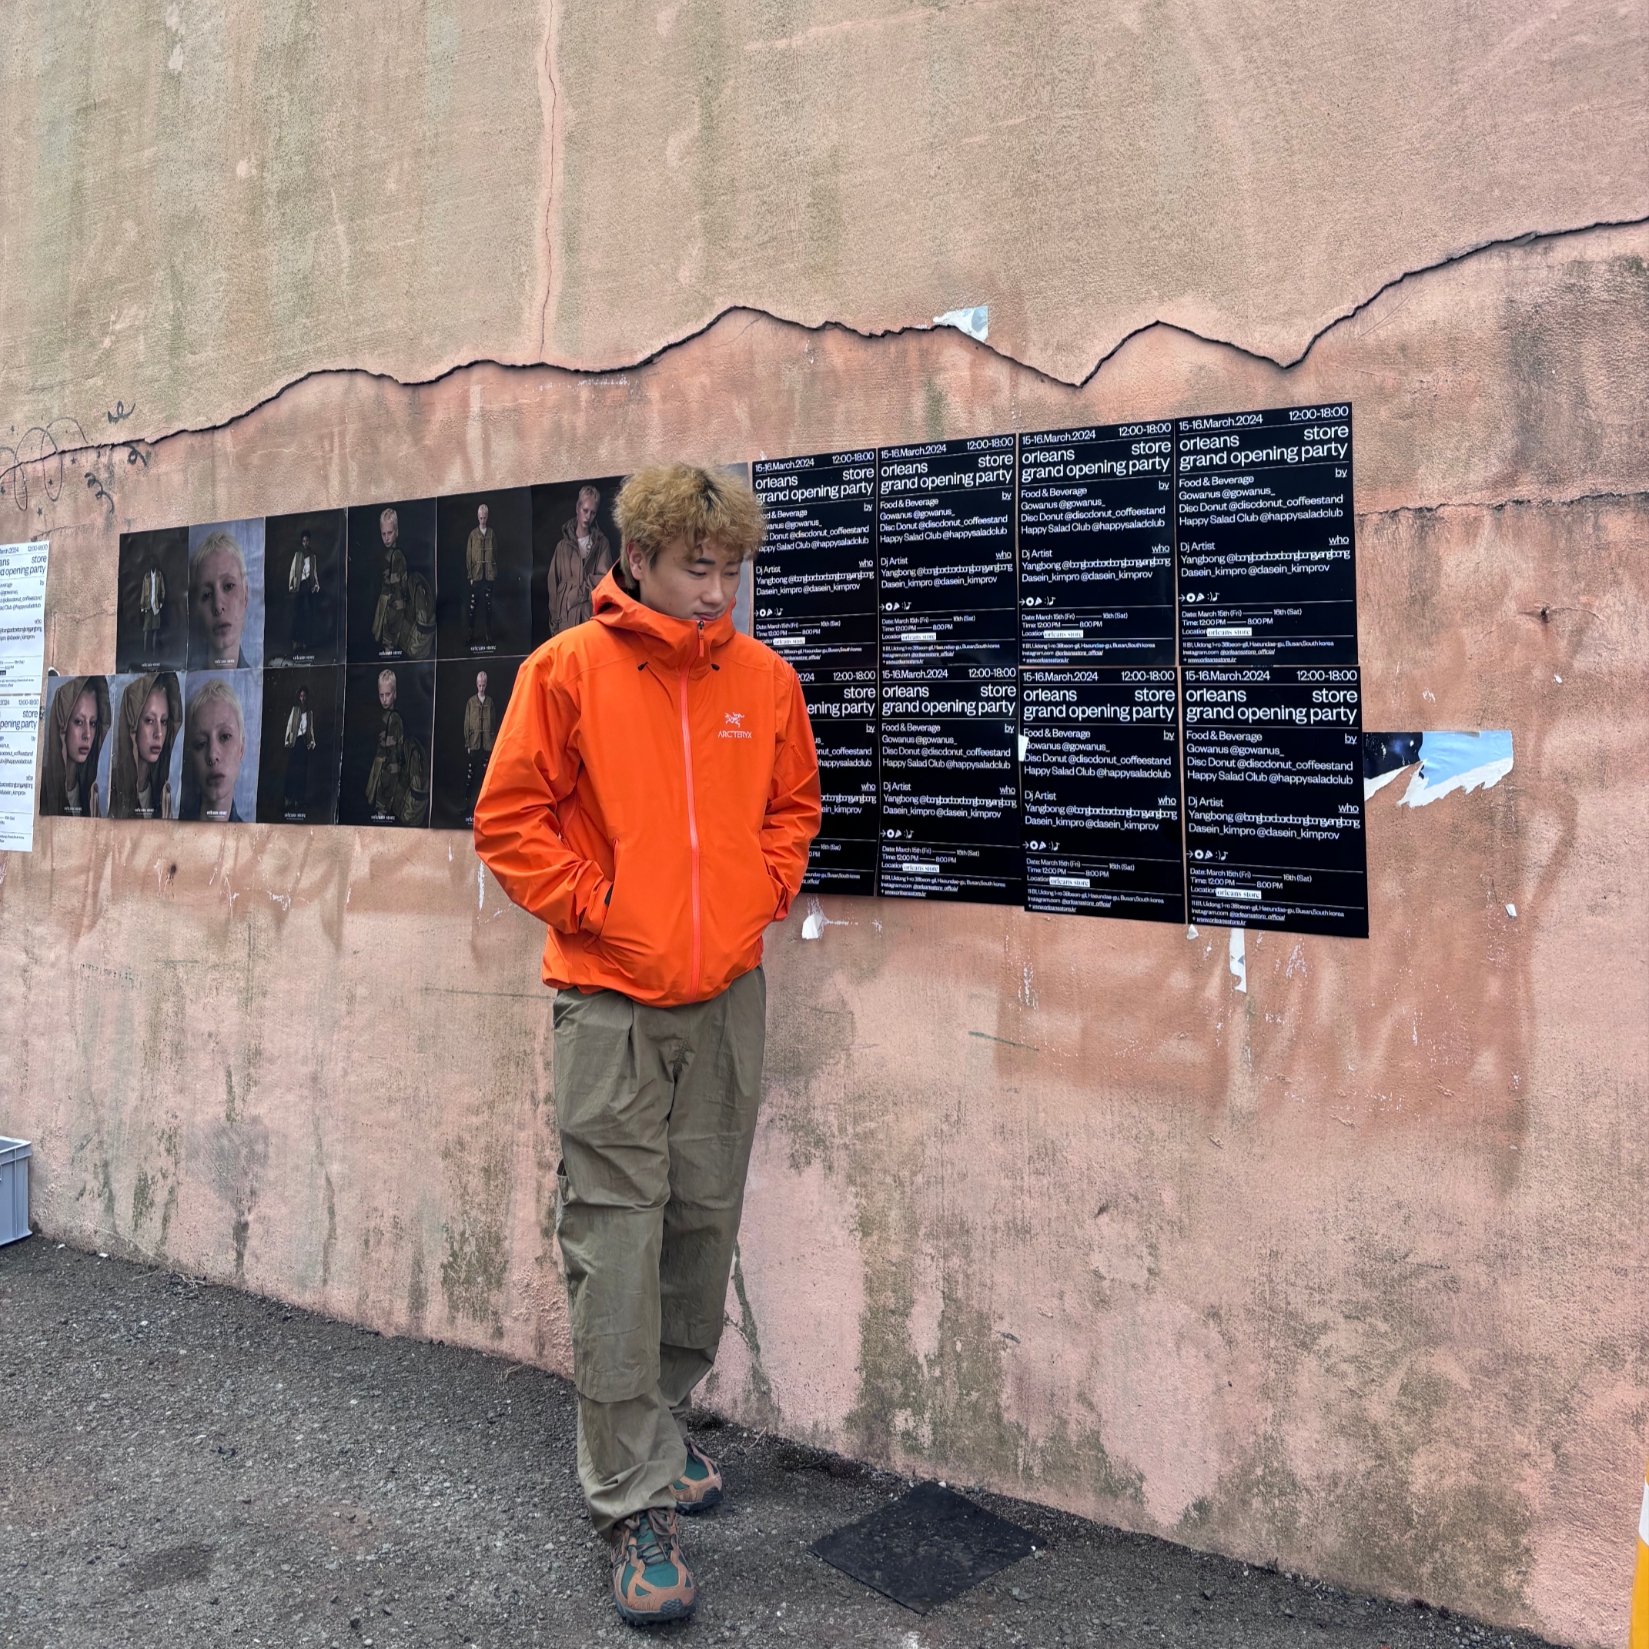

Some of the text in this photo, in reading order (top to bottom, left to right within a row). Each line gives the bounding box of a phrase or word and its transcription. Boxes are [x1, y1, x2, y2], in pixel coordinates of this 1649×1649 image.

[1289, 406, 1349, 421] 12:00-18:00
[1119, 423, 1171, 436] 12:00-18:00
[967, 437, 1013, 450] 12:00-18:00
[1180, 426, 1349, 451] orleans store
[1022, 441, 1171, 464] orleans store
[1179, 441, 1348, 471] grand opening party
[881, 454, 1013, 477] orleans store
[1021, 456, 1170, 483] grand opening party
[755, 468, 874, 489] orleans store
[1335, 468, 1347, 478] by
[880, 468, 1012, 494] grand opening party
[1159, 480, 1169, 490] by
[1179, 476, 1254, 487] Food & Beverage
[791, 485, 839, 502] opening
[841, 481, 873, 498] party
[1021, 488, 1087, 498] Food & Beverage
[1179, 488, 1275, 500] Gowanus @gowanus_
[1021, 499, 1105, 510] Gowanus @gowanus_
[1179, 494, 1343, 513] Disc Donut @discdonut_coffeestand
[1179, 508, 1343, 527] Happy Salad Club @happysaladclub
[1021, 518, 1165, 535] Happy Salad Club @happysaladclub
[1329, 535, 1349, 545] who
[1152, 543, 1170, 553] who
[1180, 541, 1215, 553] Dj Artist
[31, 554, 47, 564] store
[1022, 549, 1052, 560] Dj Artist
[1181, 554, 1225, 565] Yangbong
[6, 565, 46, 577] opening party
[1022, 561, 1061, 571] Yangbong
[968, 667, 1016, 678] 12:00-18:00
[1121, 670, 1175, 681] 12:00-18:00
[1297, 670, 1357, 681] 12:00-18:00
[844, 686, 876, 698] store
[882, 684, 1016, 698] orleans store
[1023, 687, 1175, 701] orleans store
[1186, 688, 1358, 703] orleans store
[882, 699, 1015, 716] grand opening party
[1023, 703, 1174, 722] grand opening party
[22, 710, 38, 718] store
[1186, 705, 1357, 725] grand opening party
[21, 720, 38, 730] party
[1023, 728, 1091, 739] Food & Beverage
[1163, 730, 1174, 741] by
[1186, 730, 1262, 742] Food & Beverage
[1345, 733, 1357, 745] by
[1062, 742, 1110, 752] @gowanus_
[1186, 743, 1284, 757] Gowanus @gowanus_
[1187, 756, 1353, 771] Disc Donut @discdonut_coffeestand
[1024, 766, 1171, 779] Happy Salad Club @happysaladclub
[1187, 770, 1353, 785] Happy Salad Club @happysaladclub
[1025, 790, 1056, 801] Dj Artist
[1158, 795, 1176, 806] who
[1188, 796, 1224, 808] Dj Artist
[1025, 803, 1065, 815] Yangbong
[1338, 803, 1359, 814] who
[1188, 810, 1234, 823] Yangbong
